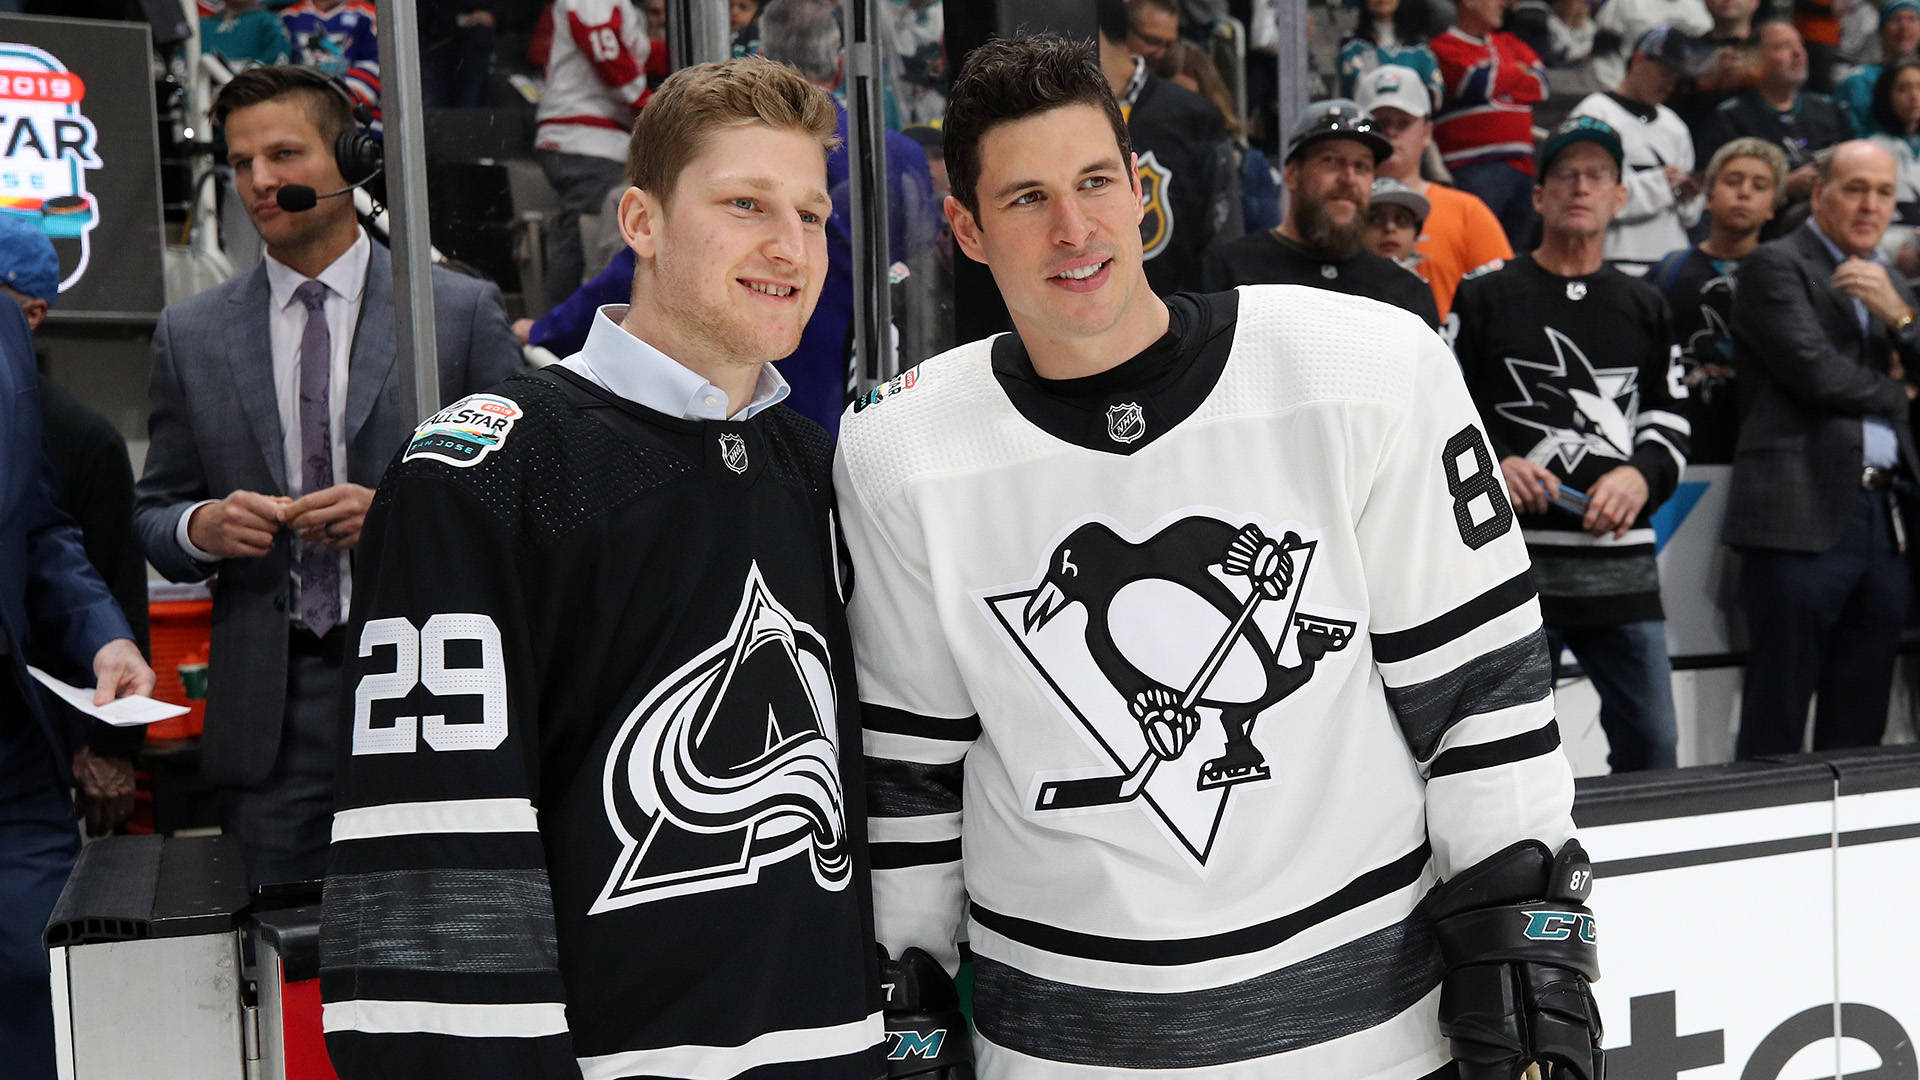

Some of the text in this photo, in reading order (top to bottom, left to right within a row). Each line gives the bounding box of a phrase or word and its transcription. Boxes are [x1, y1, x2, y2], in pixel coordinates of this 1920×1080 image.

[589, 28, 620, 61] 19
[0, 115, 94, 161] AR
[1116, 412, 1137, 436] NHL
[435, 439, 475, 455] JOSE
[352, 612, 509, 757] 29
[1569, 870, 1590, 892] 87
[884, 1028, 948, 1061] M
